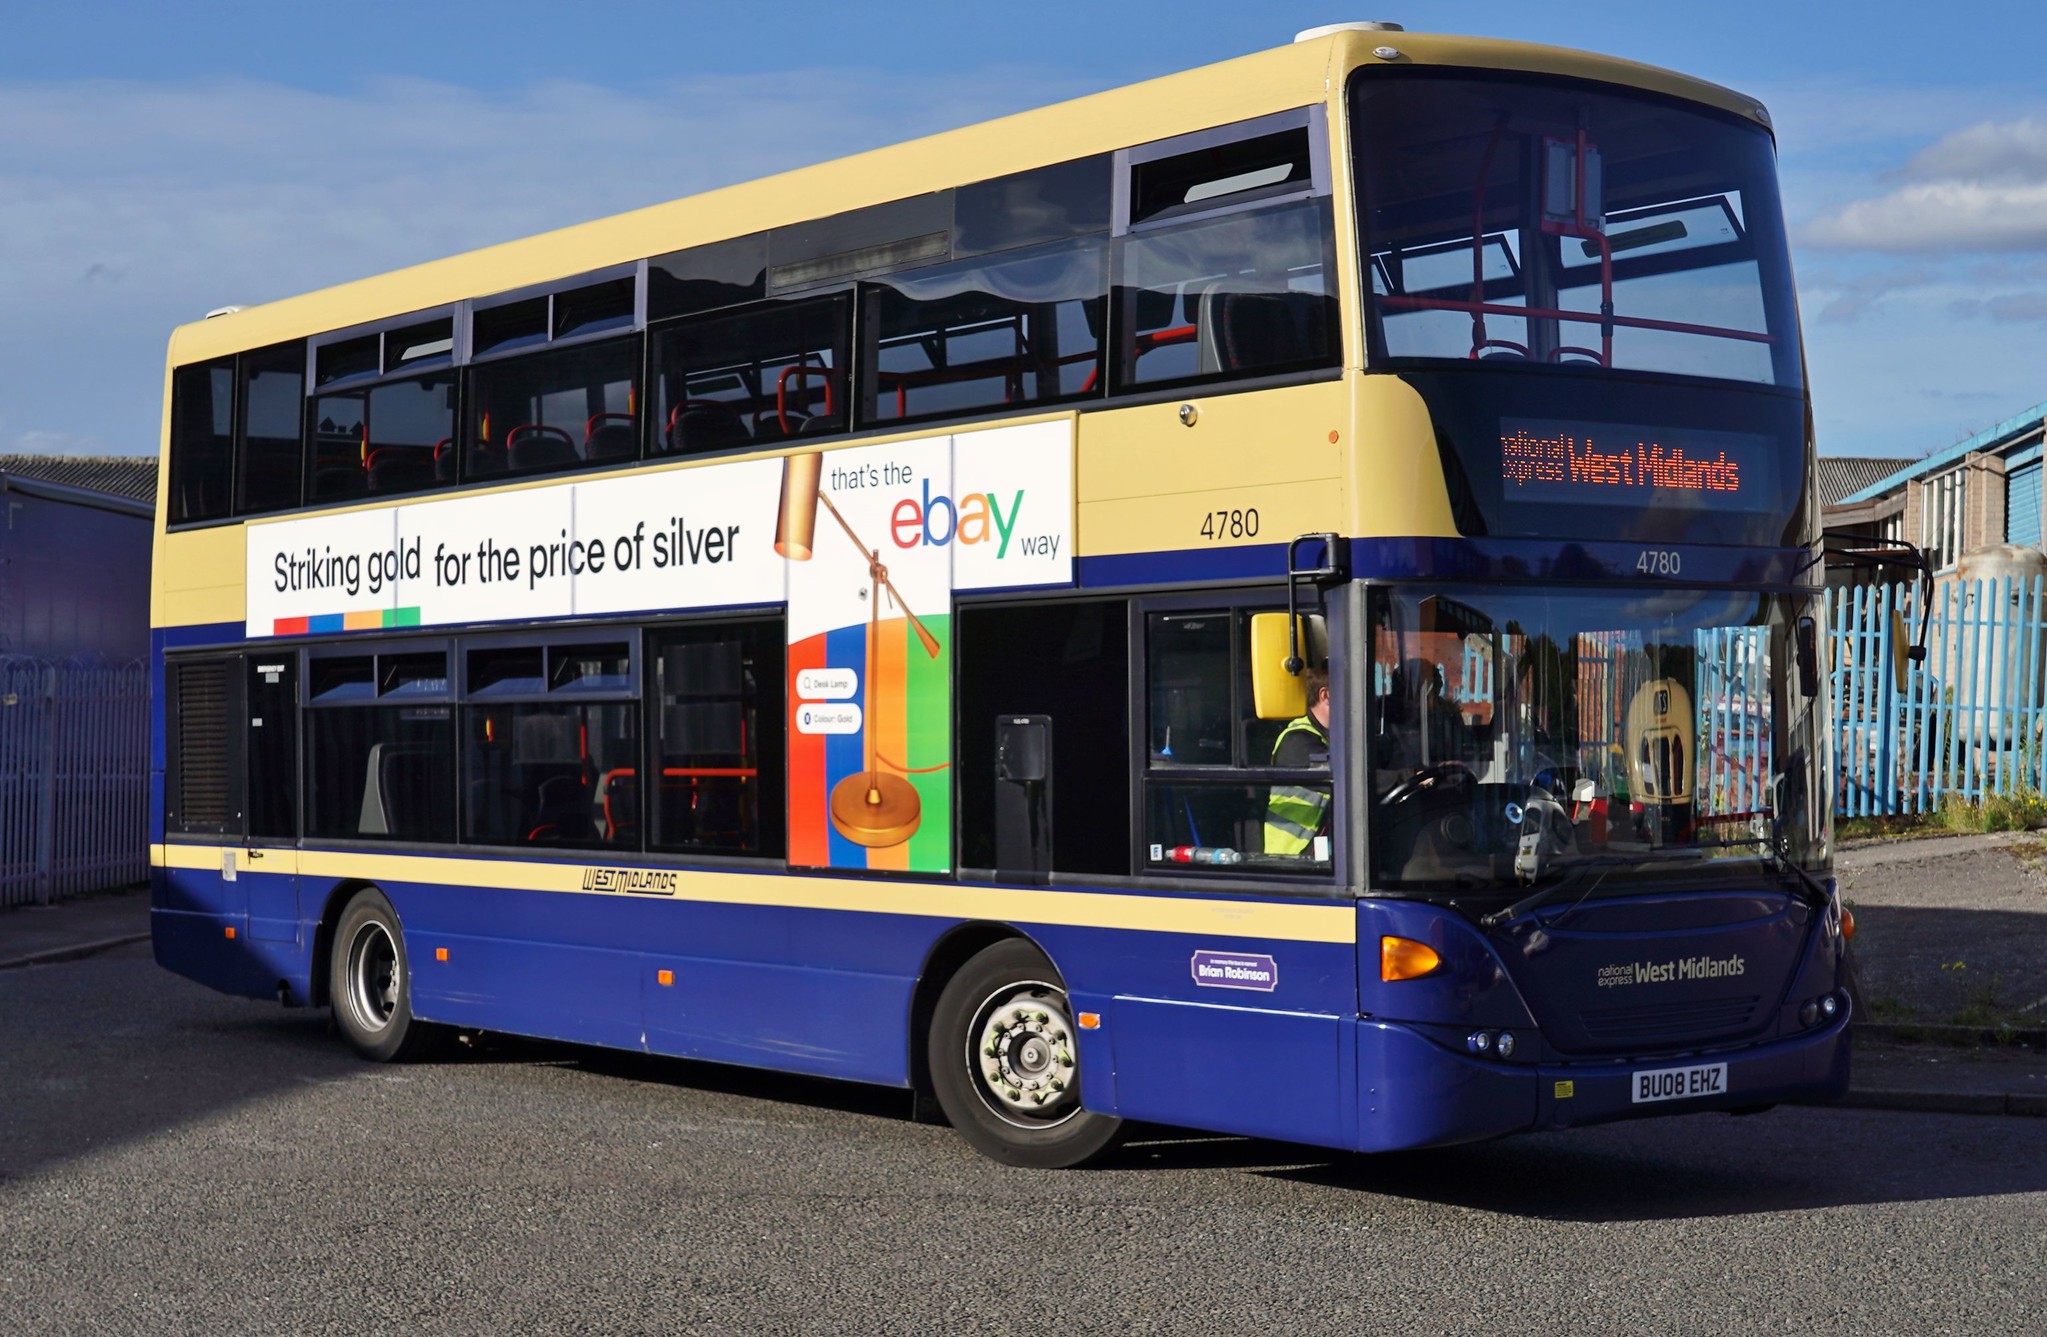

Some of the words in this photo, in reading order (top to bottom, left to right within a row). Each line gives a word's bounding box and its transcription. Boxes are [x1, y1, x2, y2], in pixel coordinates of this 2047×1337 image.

[832, 463, 879, 491] that's
[884, 461, 913, 486] the
[1568, 437, 1633, 486] West
[1637, 442, 1739, 491] Midlands
[890, 478, 1025, 559] ebay
[1200, 508, 1259, 540] 4780
[274, 545, 360, 596] Striking
[367, 535, 421, 594] gold
[434, 543, 471, 587] for
[477, 537, 520, 583] the
[529, 529, 604, 591] price
[613, 521, 645, 572] of
[653, 517, 740, 567] silver
[1021, 534, 1061, 560] way
[1636, 551, 1681, 574] 4780
[1198, 964, 1224, 978] Brian
[1224, 966, 1271, 982] Robinson
[1598, 963, 1633, 977] national
[1598, 974, 1633, 988] express
[1635, 961, 1675, 984] West
[1678, 954, 1745, 980] Midlands
[1640, 1071, 1685, 1099] BU08
[1690, 1067, 1721, 1093] EHZ
